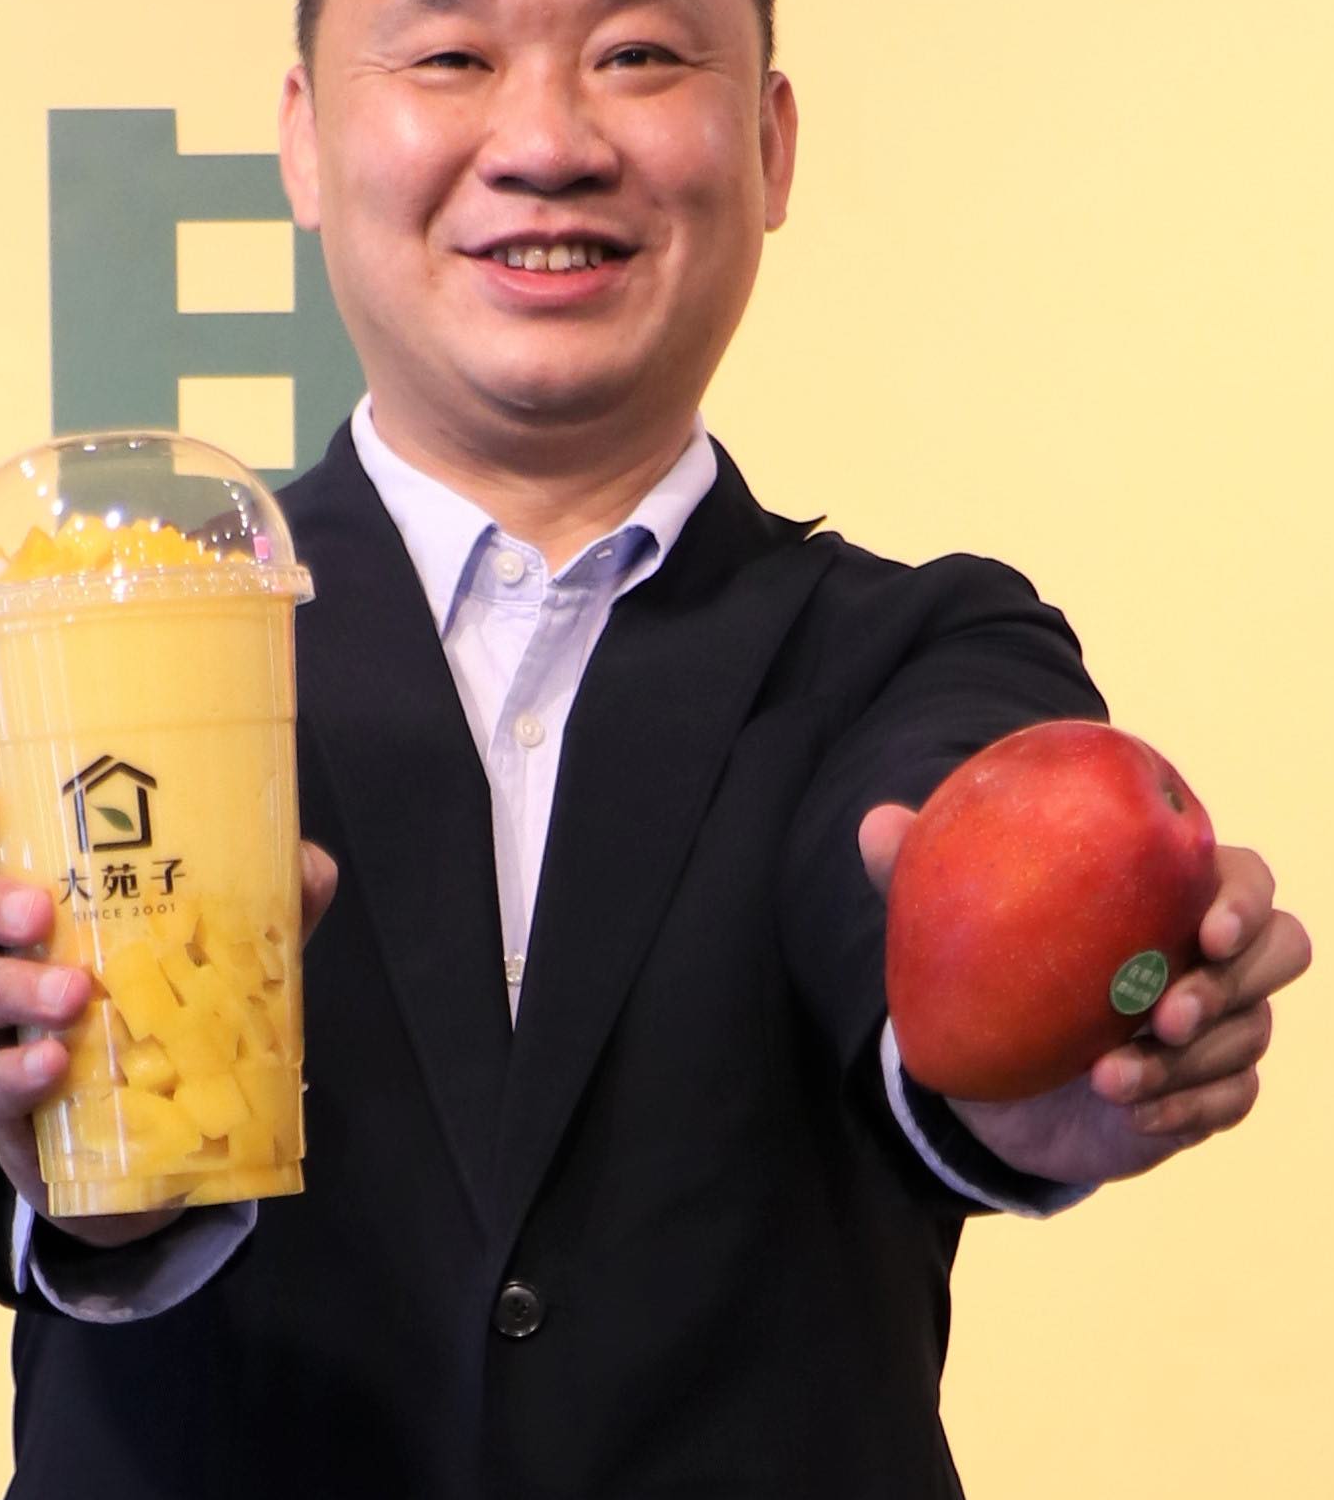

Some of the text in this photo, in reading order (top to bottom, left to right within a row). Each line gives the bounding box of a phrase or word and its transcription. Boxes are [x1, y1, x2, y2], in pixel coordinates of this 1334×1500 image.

[59, 858, 186, 905] 大苑子
[132, 902, 177, 917] 2001
